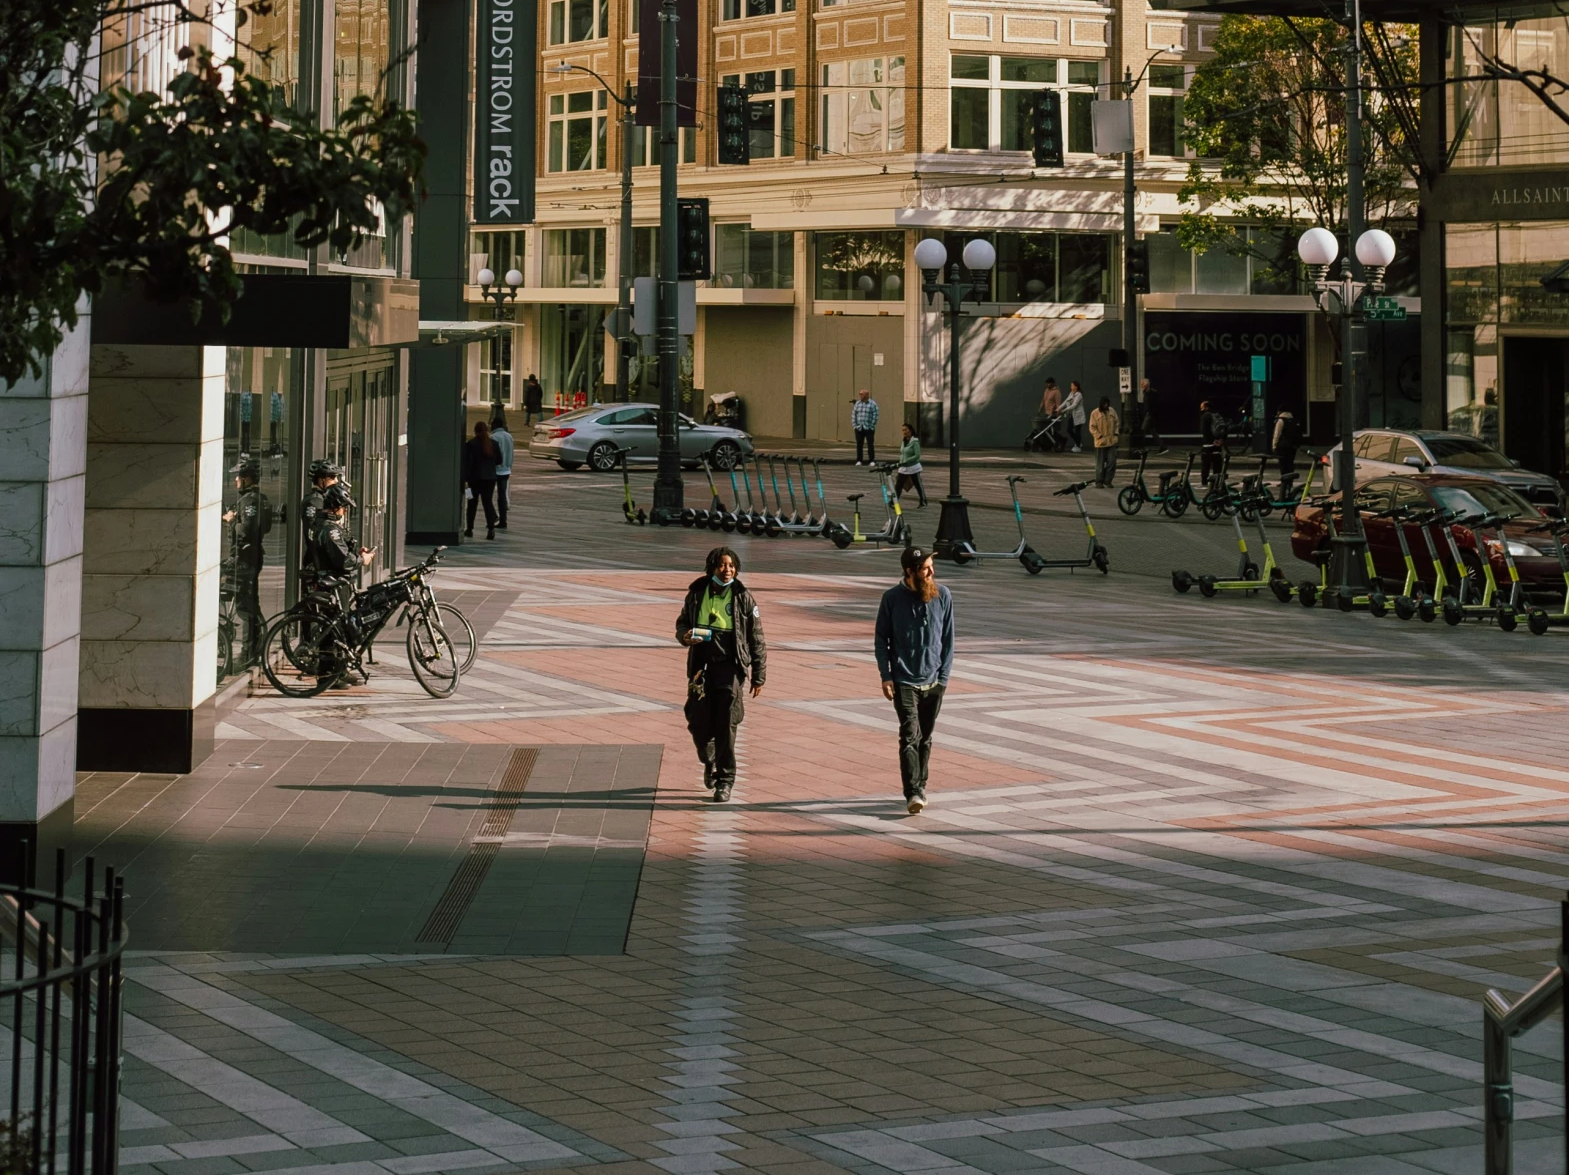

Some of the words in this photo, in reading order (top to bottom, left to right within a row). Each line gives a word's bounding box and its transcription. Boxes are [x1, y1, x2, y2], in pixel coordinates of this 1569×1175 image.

[489, 145, 520, 218] rack
[1146, 332, 1233, 351] COMING
[1240, 333, 1300, 351] SOON
[1197, 363, 1210, 371] The
[1212, 363, 1226, 371] Ben
[1198, 375, 1227, 383] Flagship
